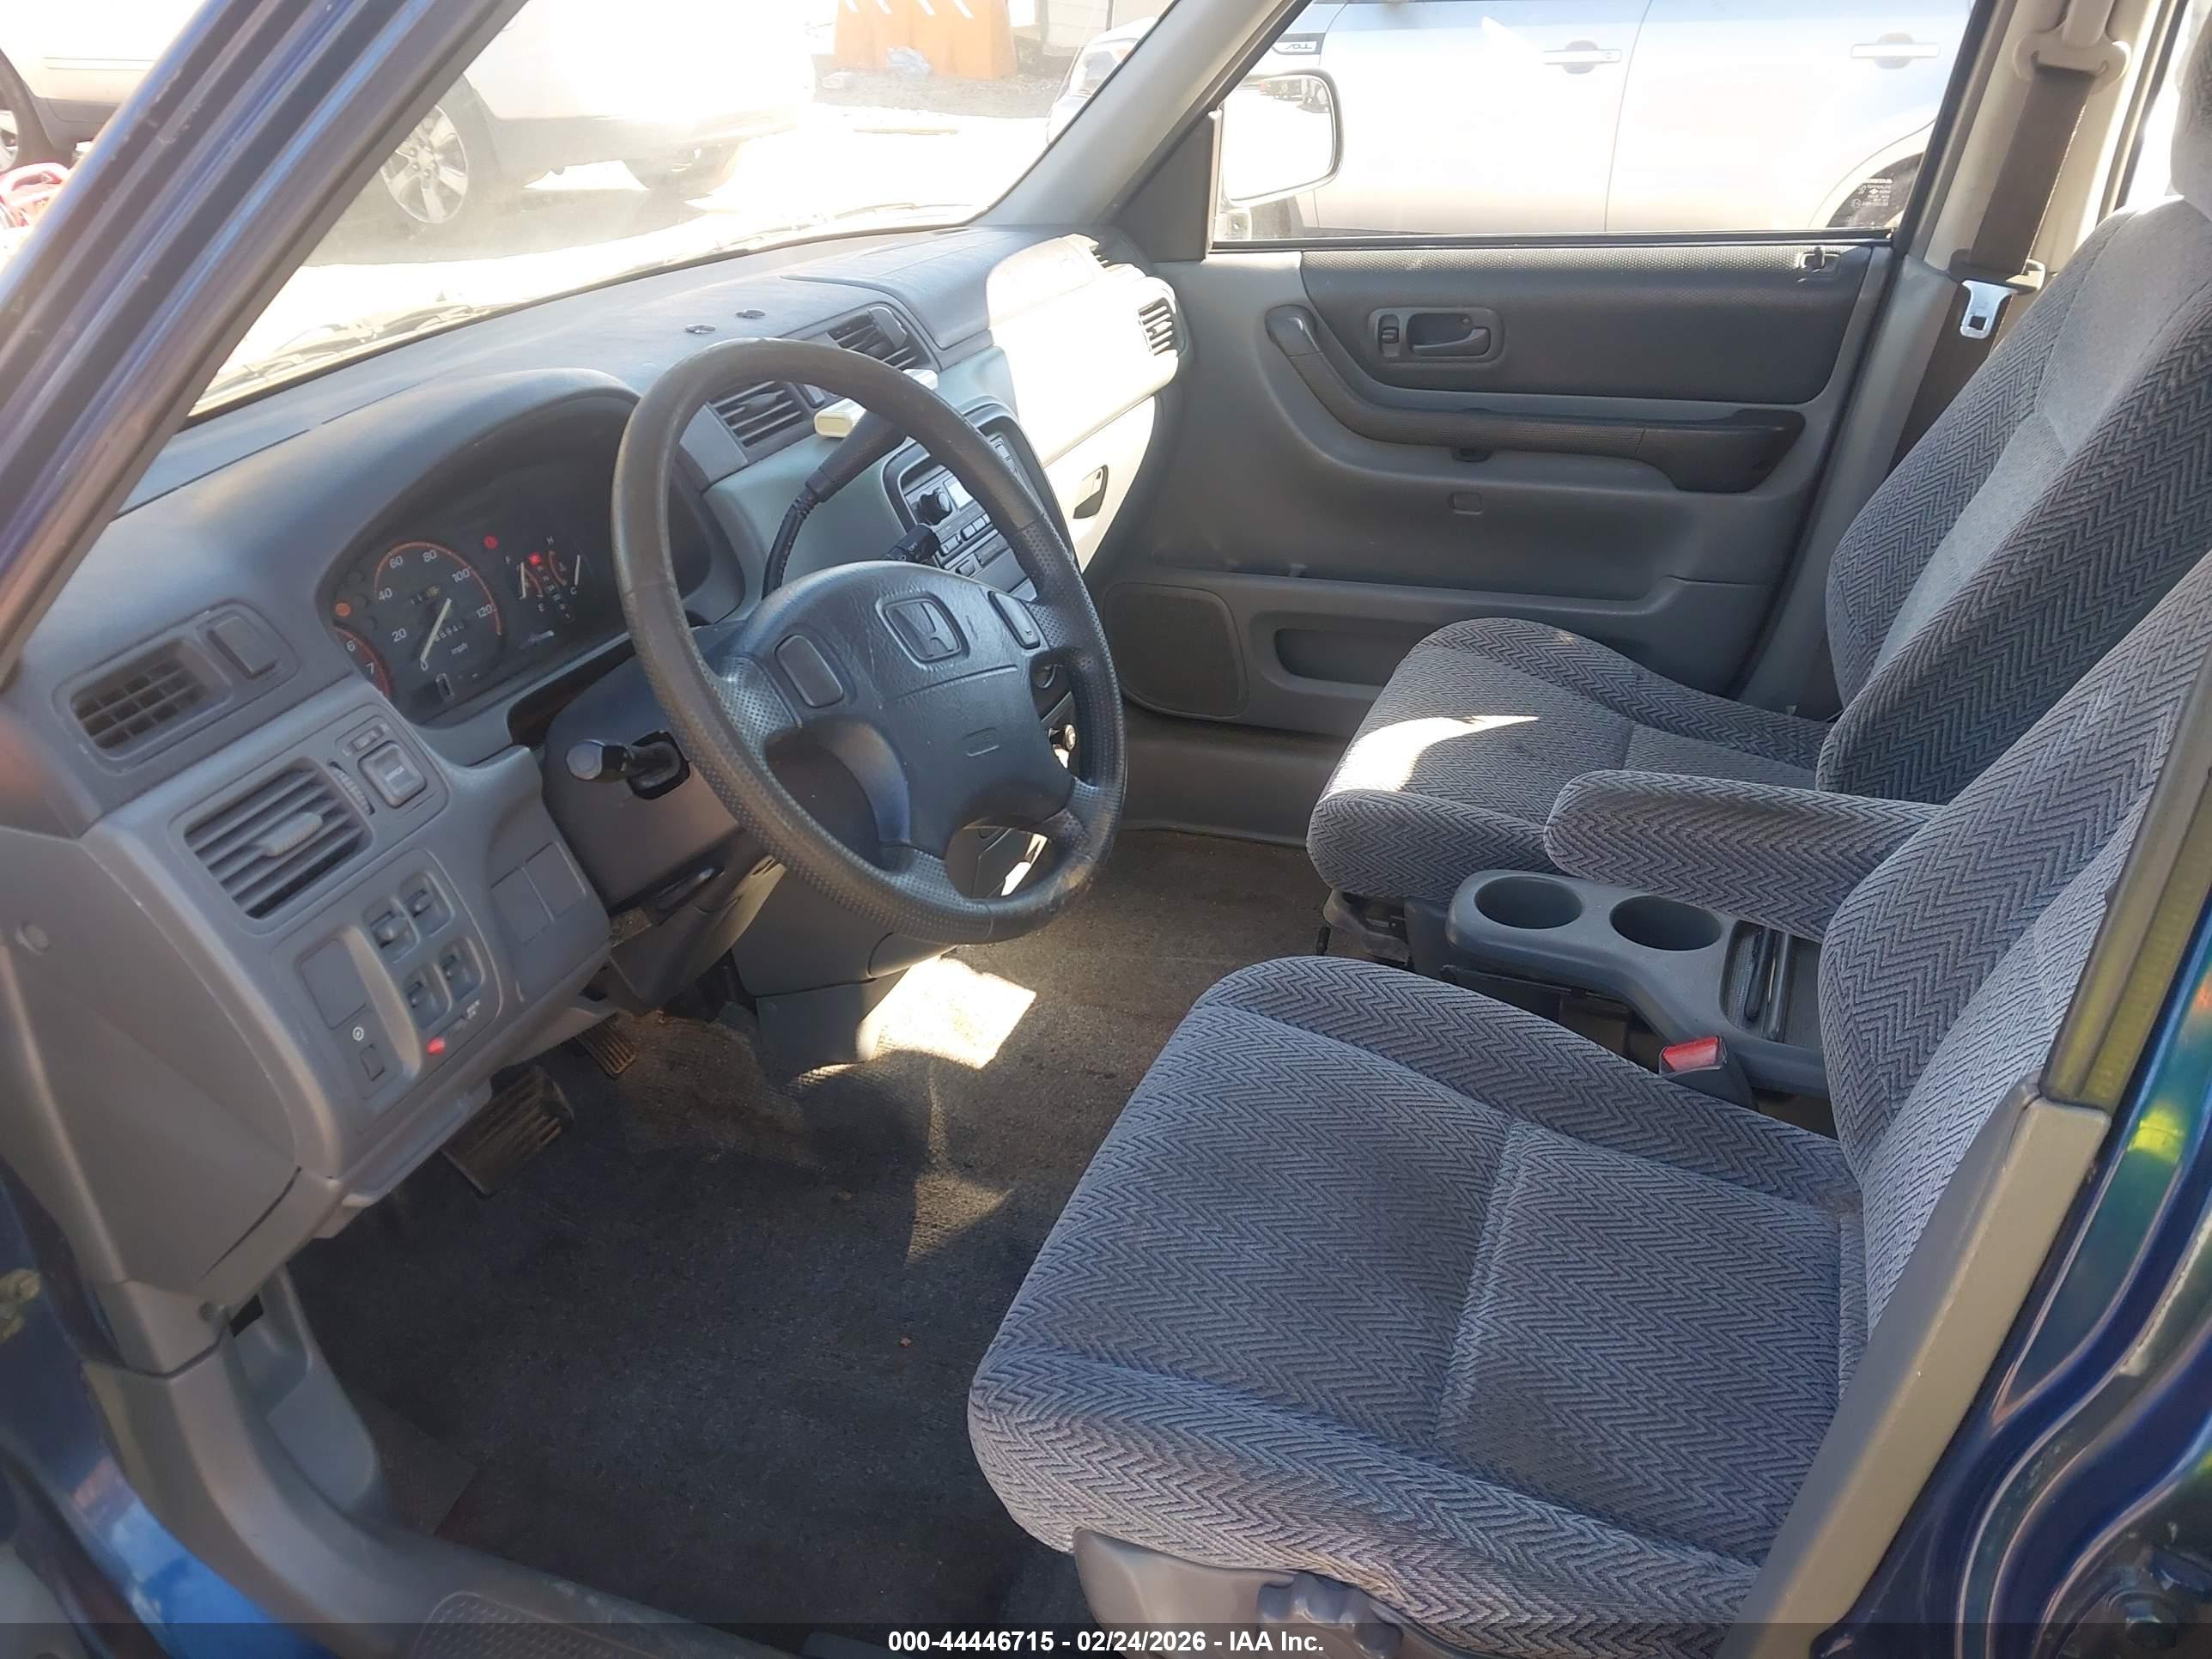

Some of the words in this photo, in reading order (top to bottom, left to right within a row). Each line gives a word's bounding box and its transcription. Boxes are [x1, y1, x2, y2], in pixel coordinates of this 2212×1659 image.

[389, 556, 404, 568] 60
[422, 550, 437, 562] 80
[452, 568, 471, 582] 100
[378, 587, 392, 601] 40
[476, 604, 493, 618] 120
[392, 628, 407, 642] 20
[346, 641, 356, 652] 6
[366, 662, 375, 674] 7
[420, 659, 428, 671] 0
